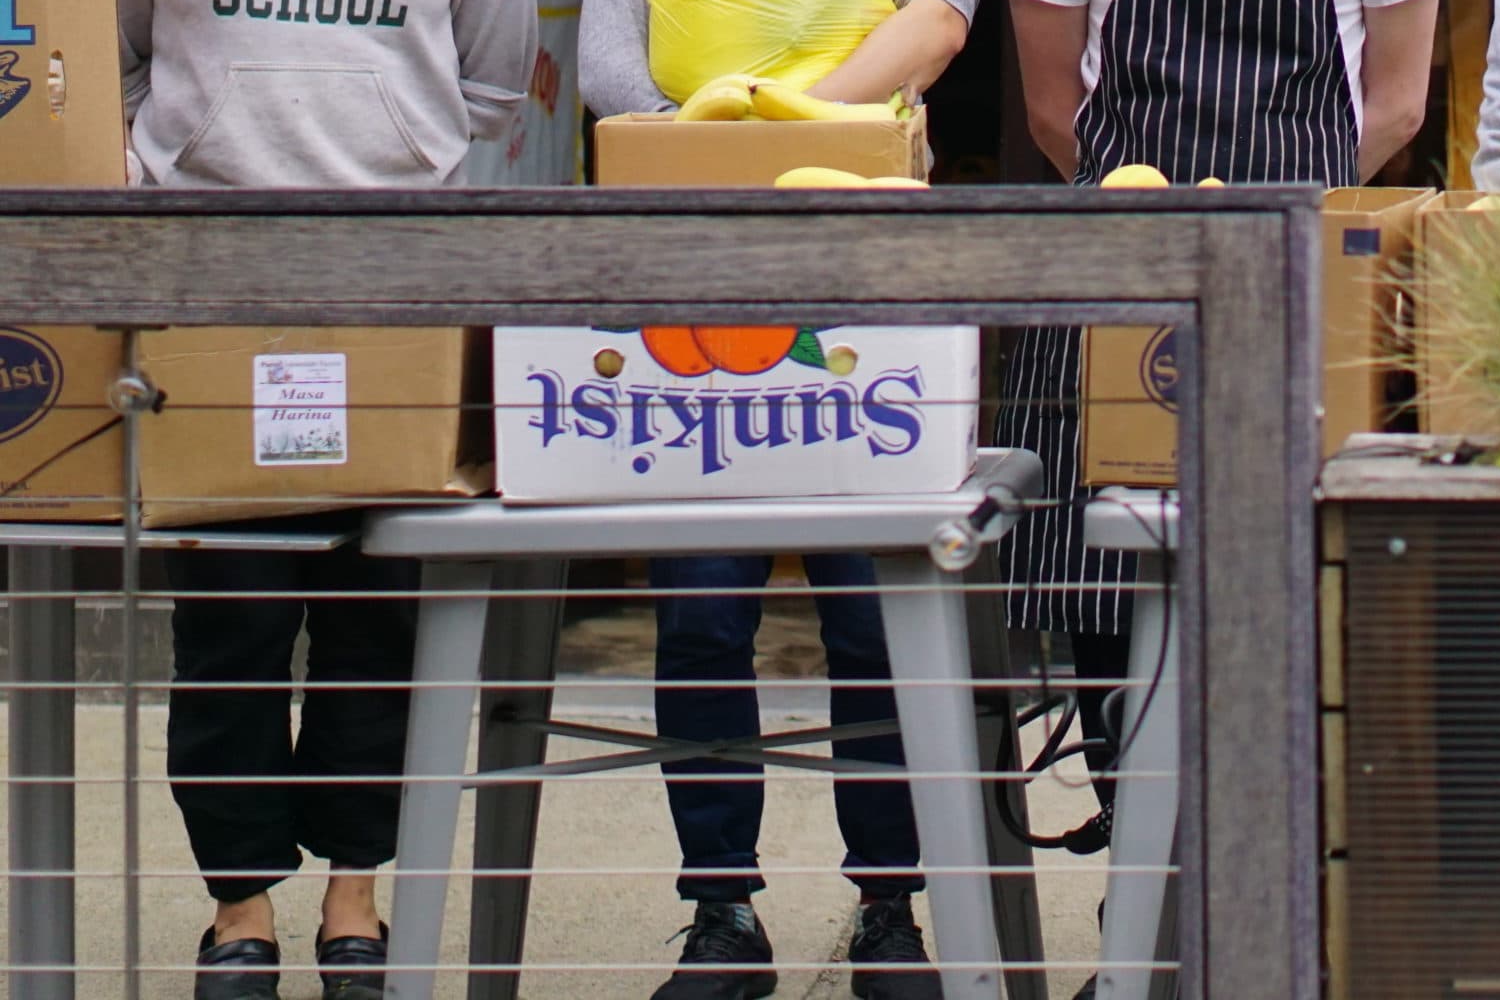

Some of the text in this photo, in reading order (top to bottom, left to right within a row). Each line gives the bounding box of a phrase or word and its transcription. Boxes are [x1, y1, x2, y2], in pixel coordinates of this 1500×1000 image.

[278, 388, 325, 401] Masa
[270, 407, 333, 422] Harina
[527, 363, 927, 476] Sunkist
